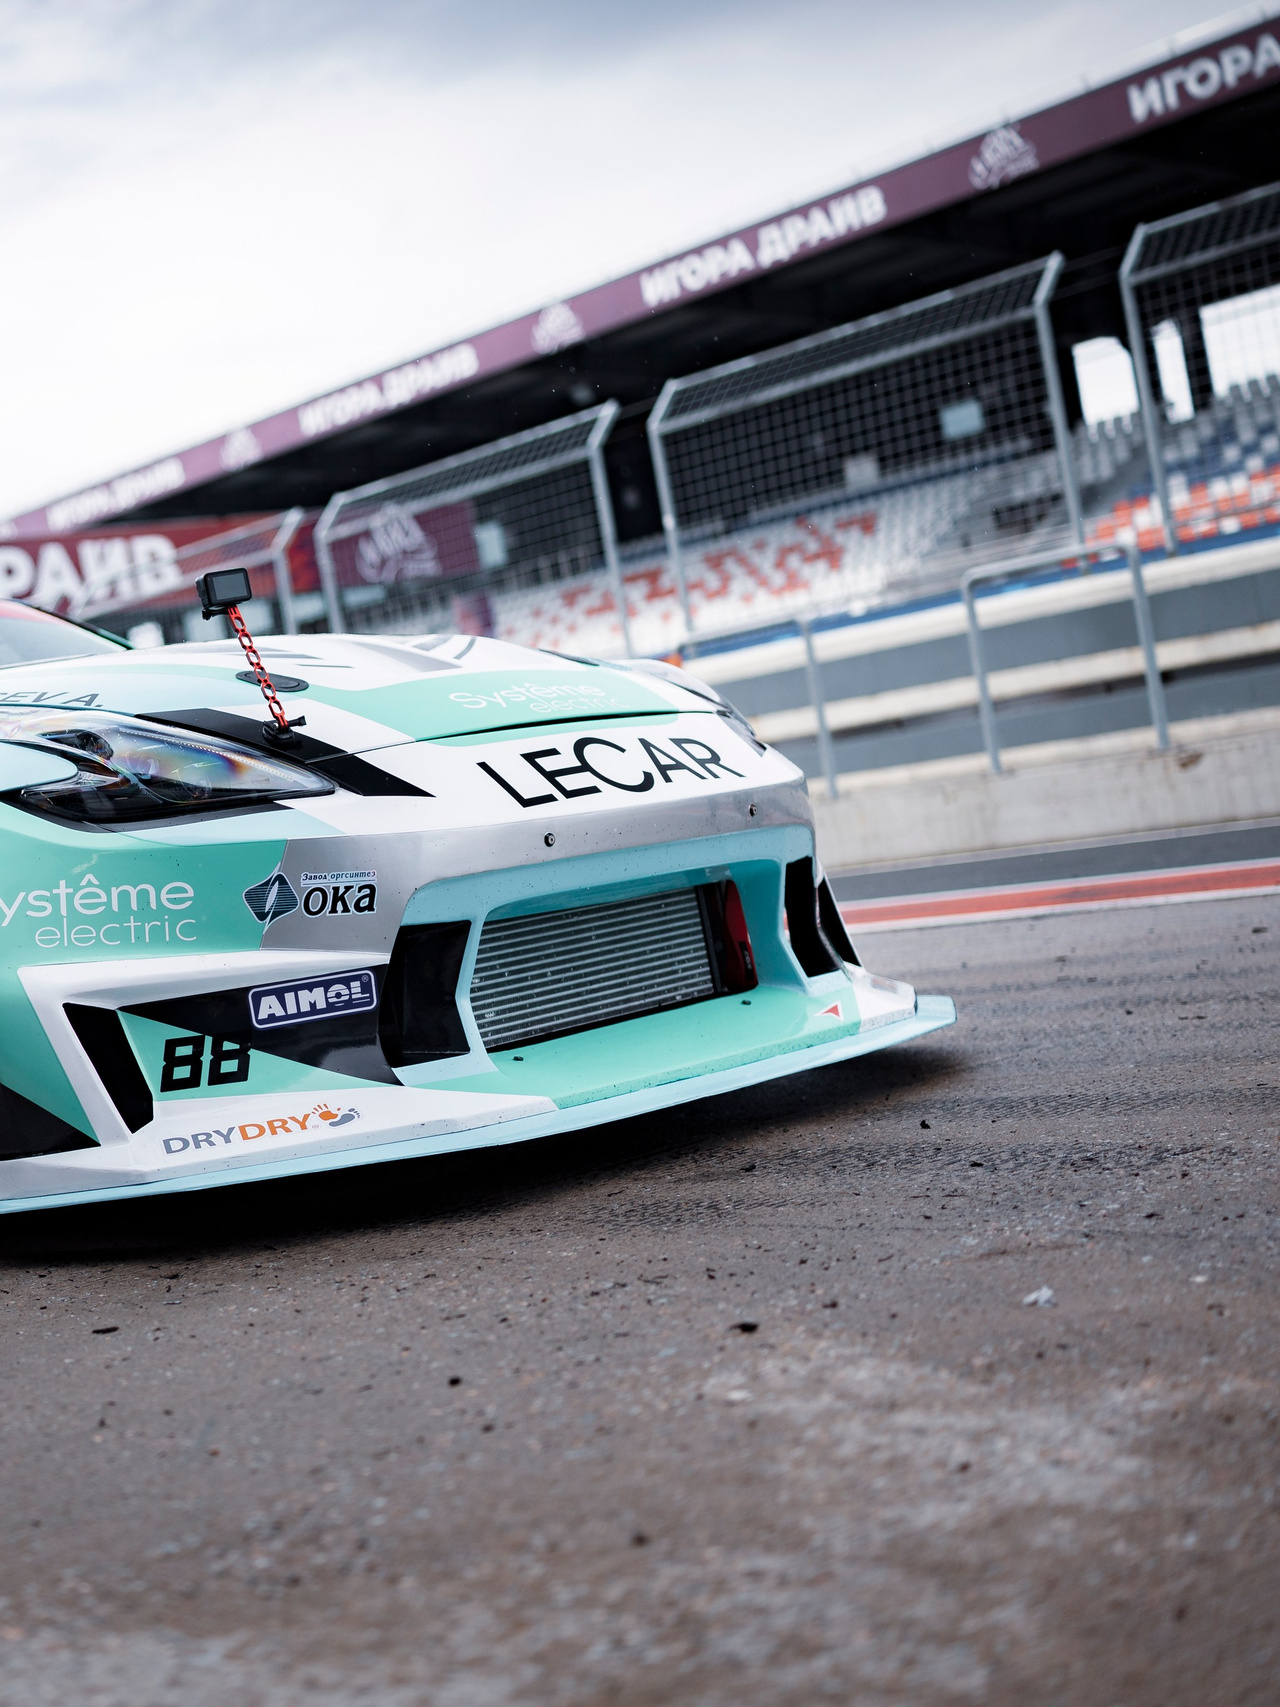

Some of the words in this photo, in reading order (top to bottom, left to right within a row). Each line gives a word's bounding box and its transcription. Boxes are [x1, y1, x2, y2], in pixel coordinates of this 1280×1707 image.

[1127, 32, 1280, 124] ИГОРА
[639, 237, 756, 307] ИГОРА
[530, 696, 631, 713] electric
[477, 736, 747, 808] LECAR
[302, 873, 328, 882] Завод
[330, 870, 376, 881] оргсинтез
[35, 914, 197, 948] electric
[258, 981, 370, 1020] AIMOL
[160, 1031, 252, 1093] 88
[163, 1113, 311, 1154] DRYDRY
